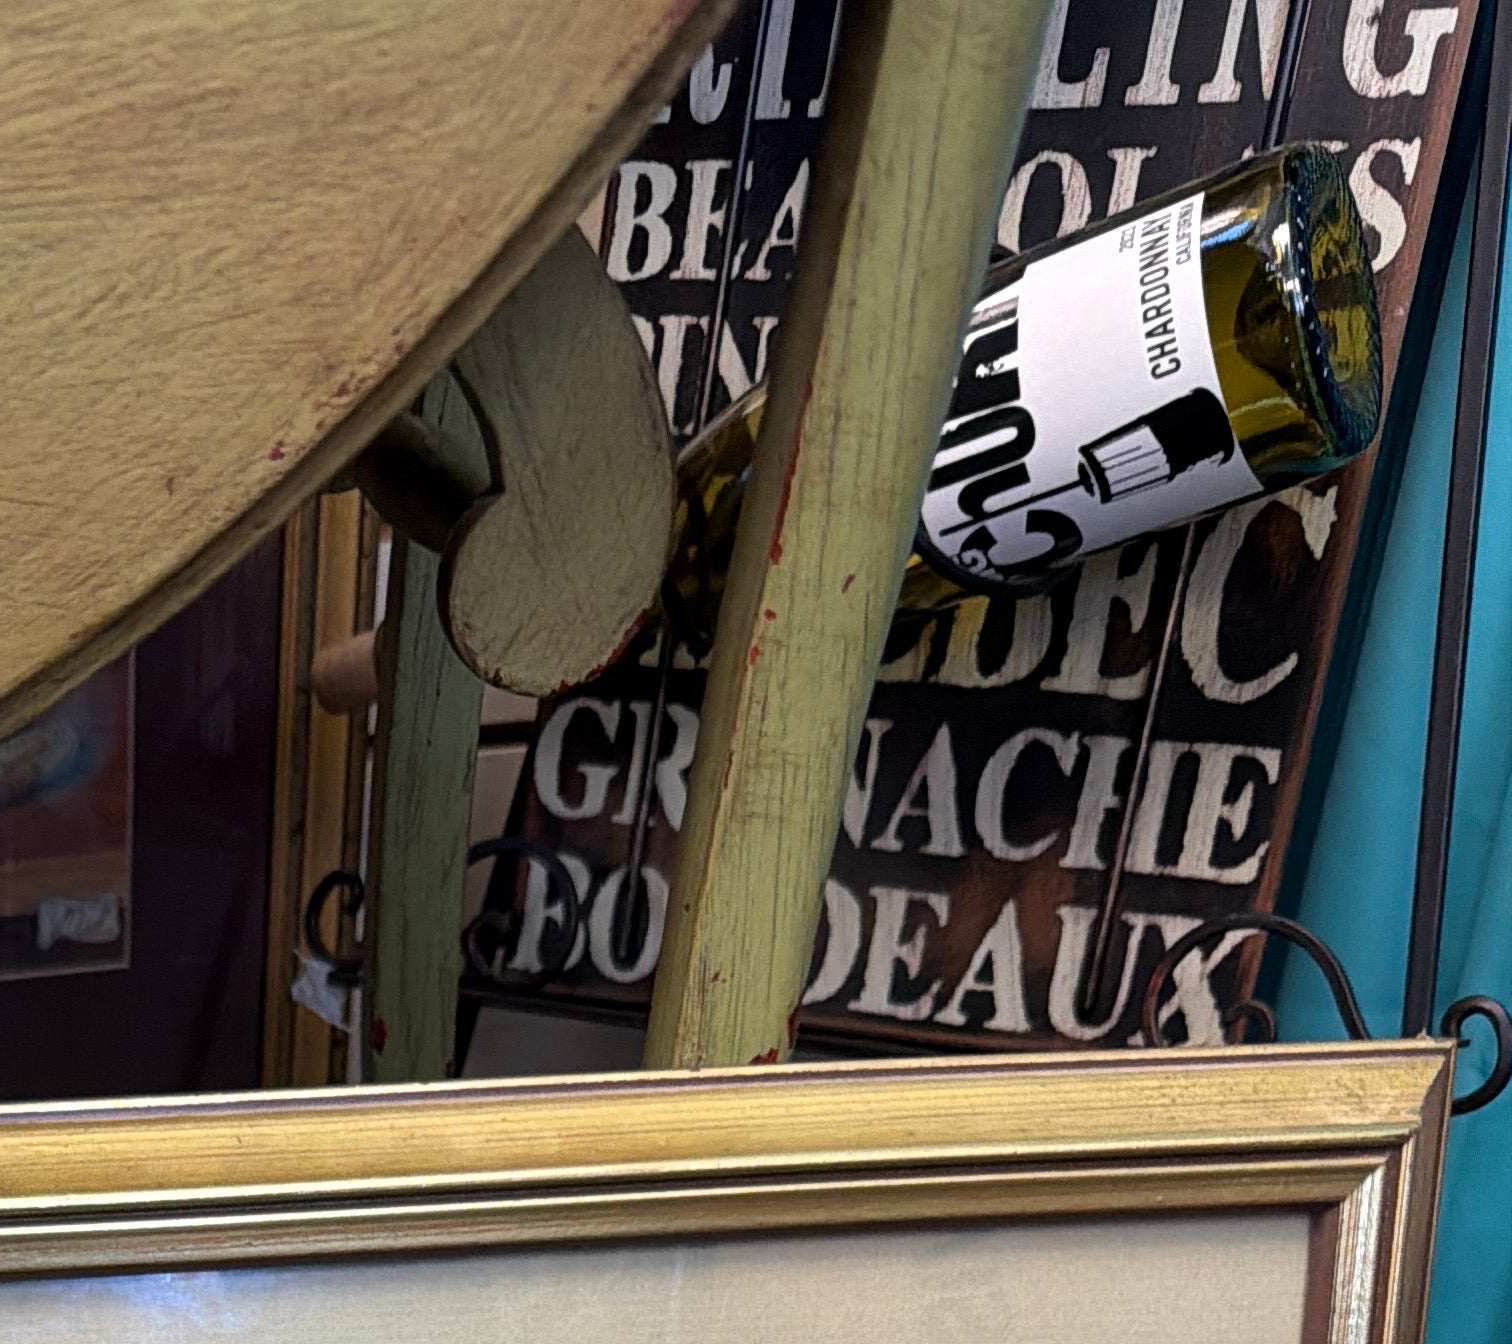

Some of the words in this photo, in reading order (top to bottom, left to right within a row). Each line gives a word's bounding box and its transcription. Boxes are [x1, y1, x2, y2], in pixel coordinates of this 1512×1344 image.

[1139, 213, 1182, 380] CHARDONNAY
[534, 700, 1283, 885] GRNACHE
[506, 853, 1263, 1048] BODEAUX
